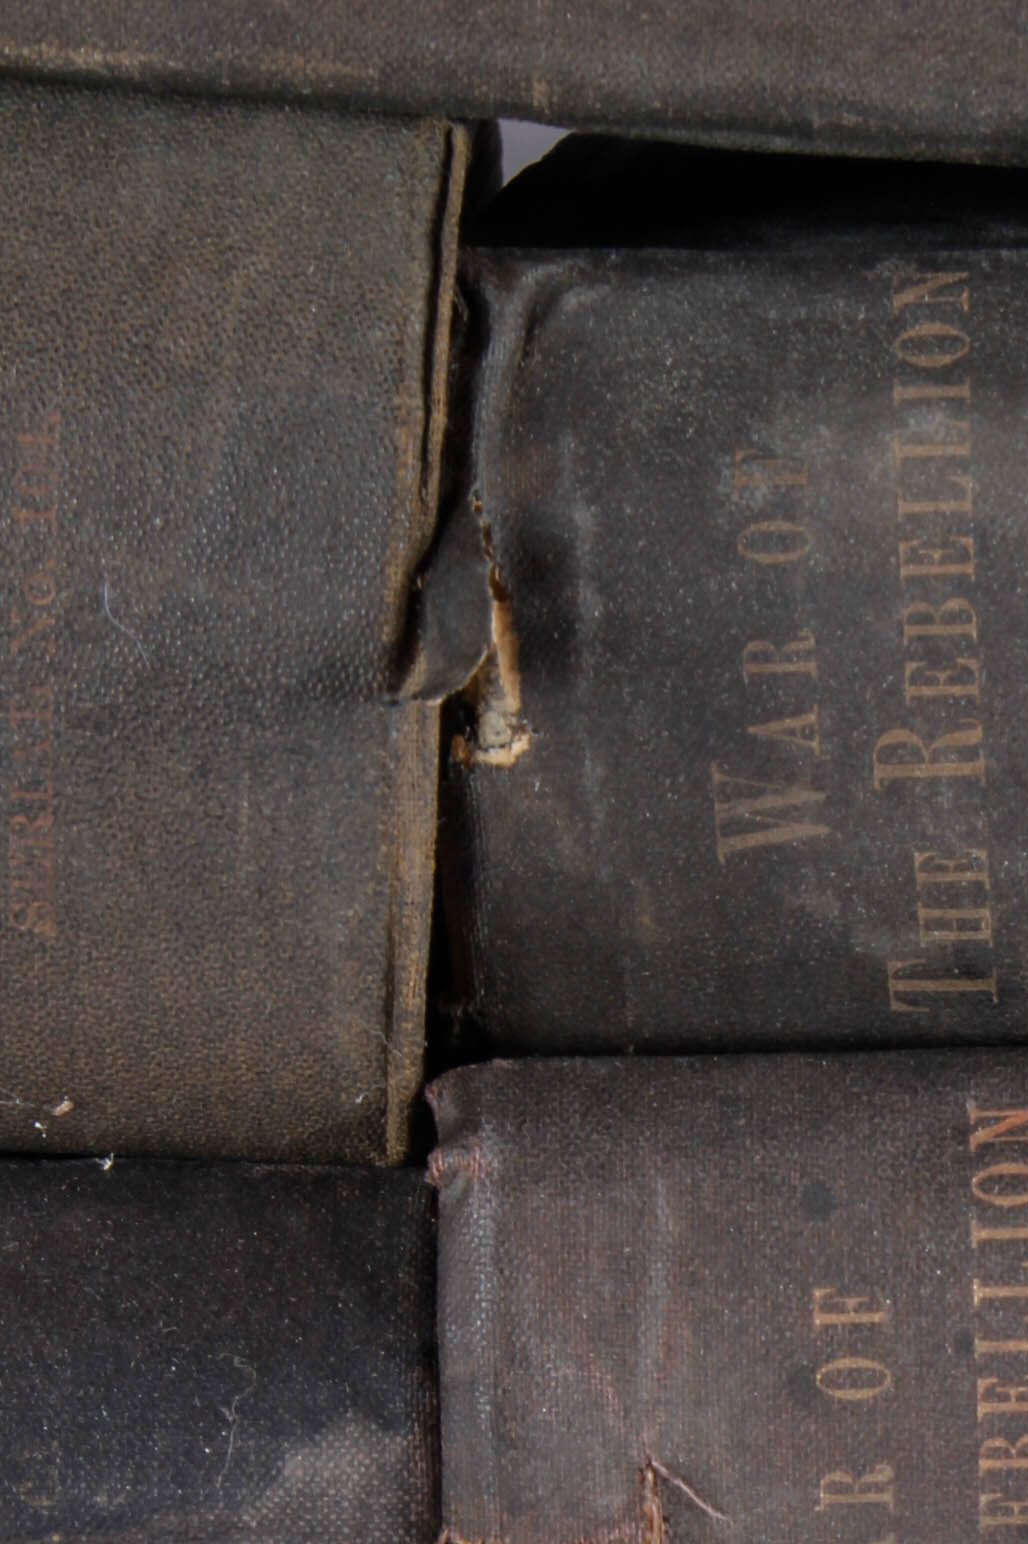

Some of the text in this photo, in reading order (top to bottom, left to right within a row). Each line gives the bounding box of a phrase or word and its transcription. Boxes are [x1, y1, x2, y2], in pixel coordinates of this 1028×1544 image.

[710, 446, 832, 863] WAR OF
[872, 267, 998, 1012] THE REBELLION
[812, 1284, 894, 1401] OF
